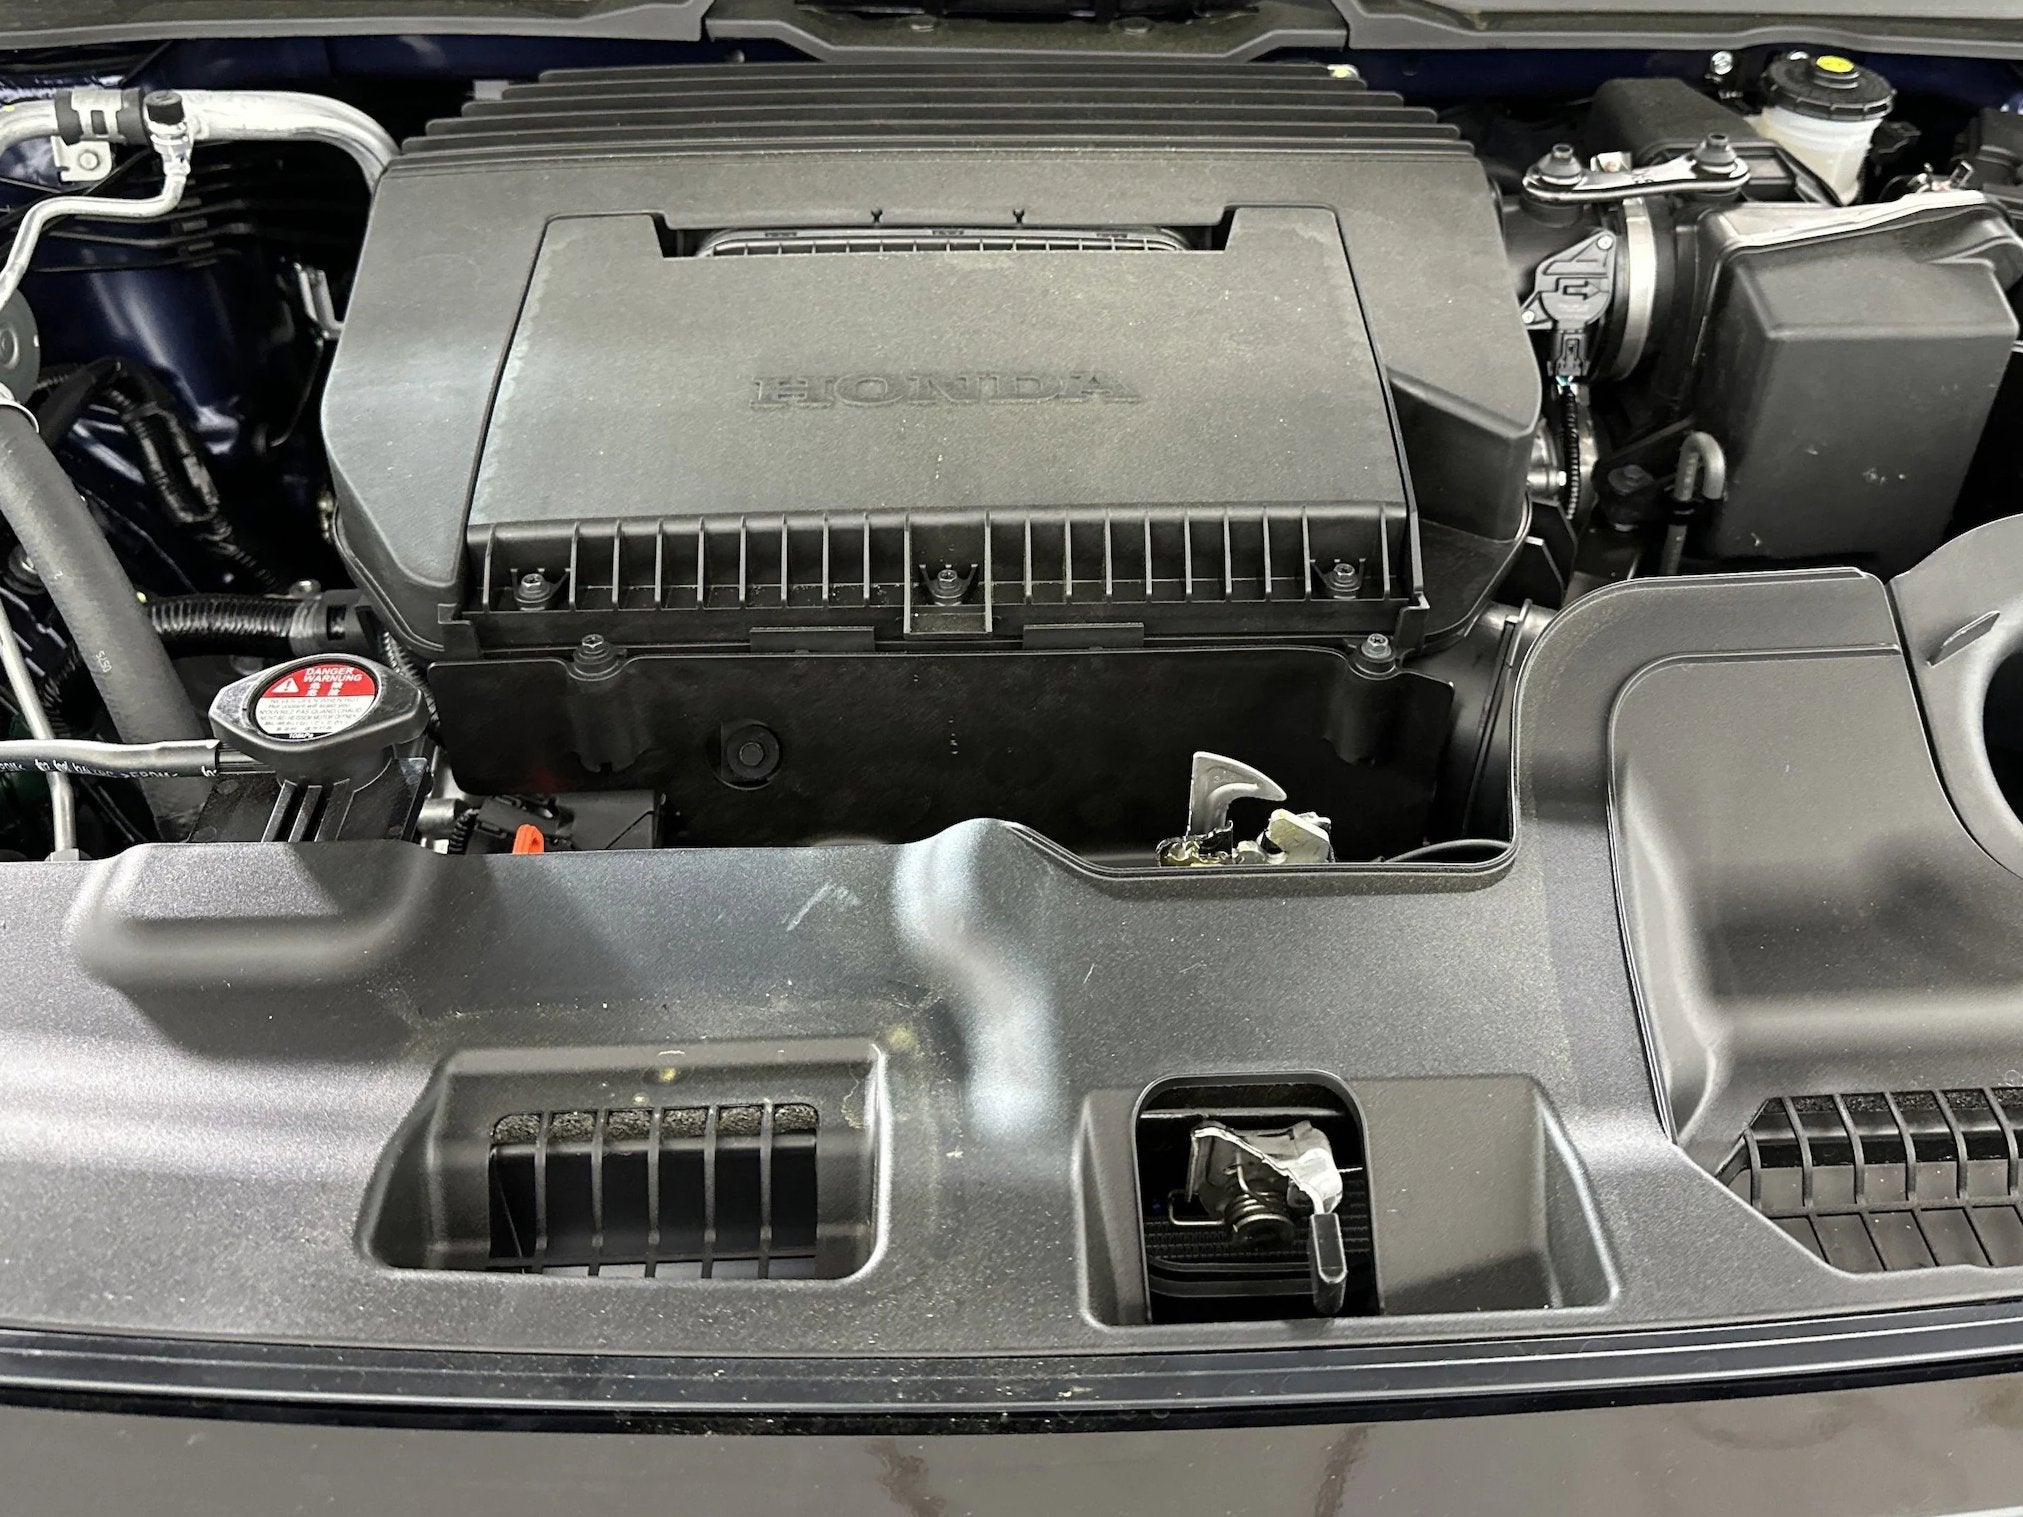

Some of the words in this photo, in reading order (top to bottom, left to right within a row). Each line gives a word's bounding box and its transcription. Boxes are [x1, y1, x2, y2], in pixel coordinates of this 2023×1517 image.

[750, 371, 1141, 408] HONDA
[305, 667, 355, 675] DANGER
[303, 674, 363, 682] WARNUNG
